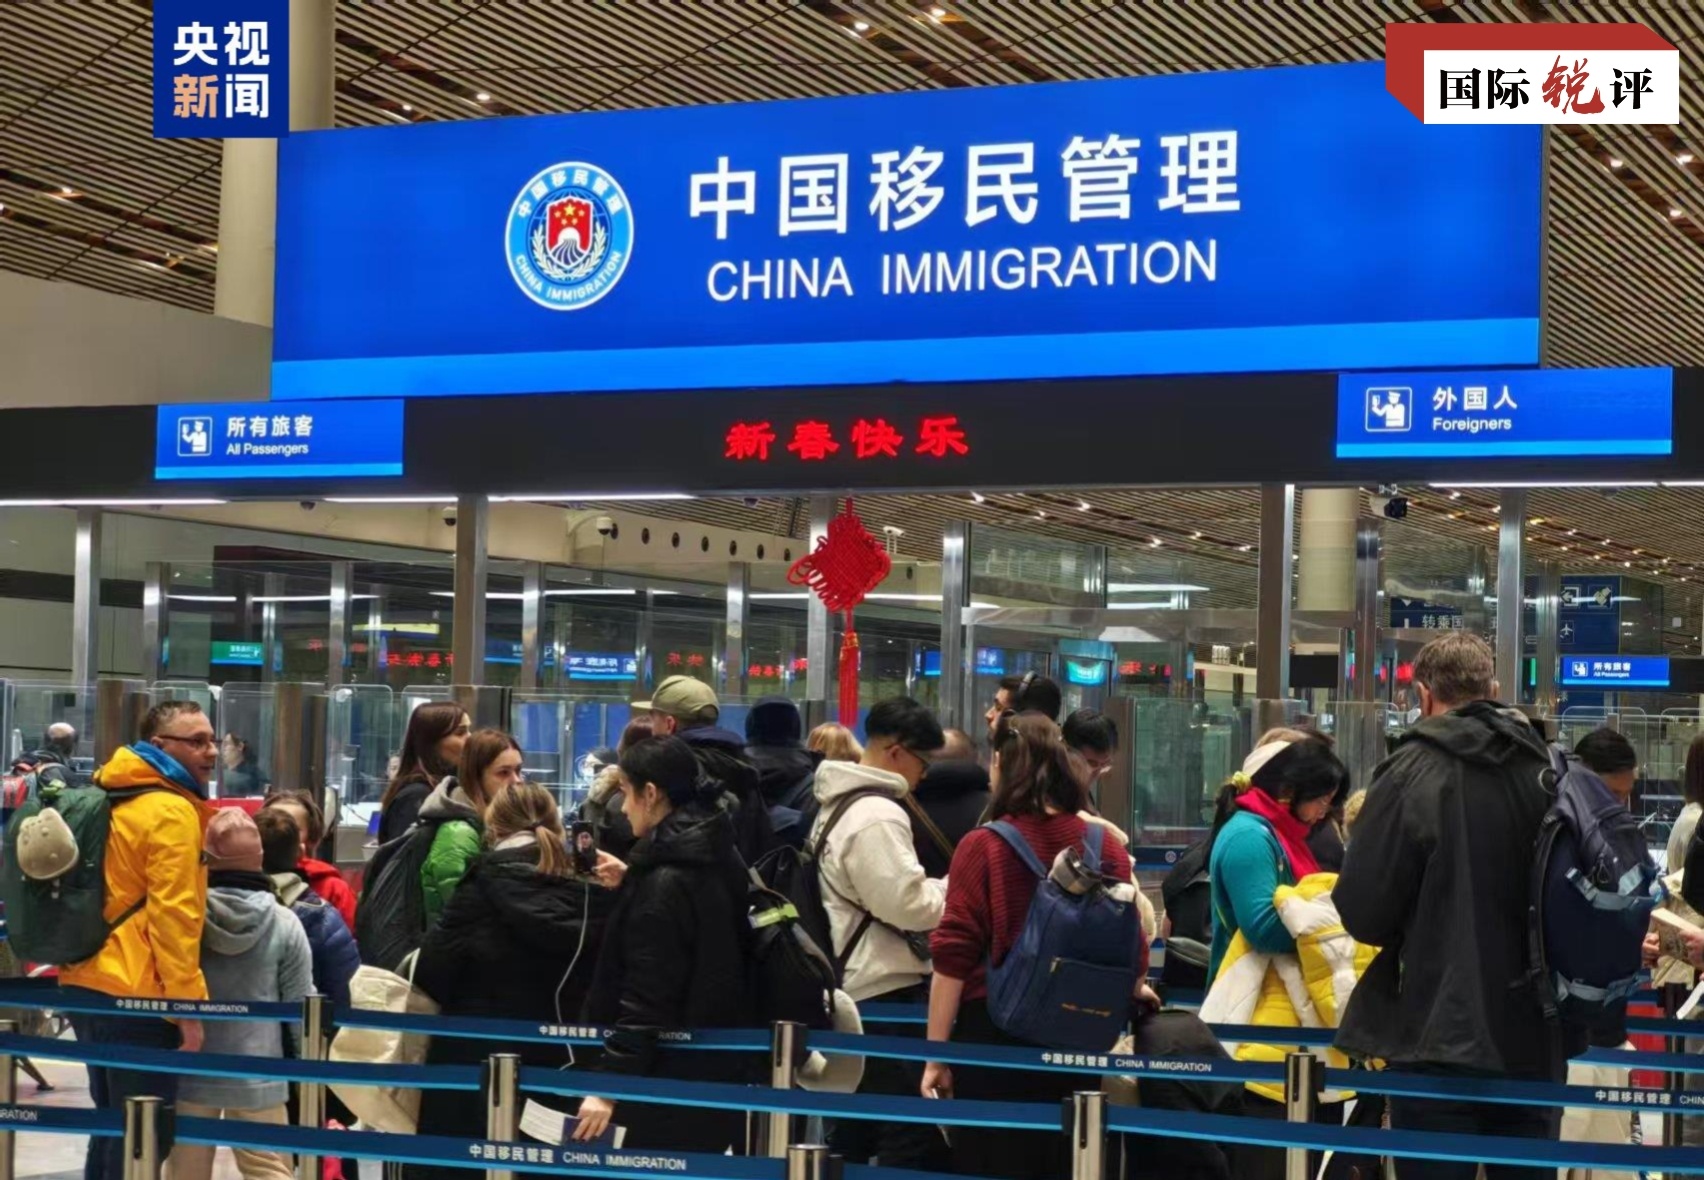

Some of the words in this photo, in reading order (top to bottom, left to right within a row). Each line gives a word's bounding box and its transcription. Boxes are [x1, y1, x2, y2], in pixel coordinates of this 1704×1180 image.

[689, 130, 1241, 241] 中国移民管理
[516, 254, 543, 294] CHINA
[546, 251, 622, 301] IMMIGRATION
[707, 256, 854, 302] CHINA
[880, 239, 1217, 296] IMMIGRATION
[1432, 385, 1518, 411] 外国人
[227, 414, 313, 438] 所有旅客
[1432, 416, 1512, 434] Foreigners
[724, 415, 969, 460] 新春快乐
[226, 443, 241, 455] All
[243, 442, 309, 457] Passengers
[173, 1002, 196, 1011] CHINA
[199, 1005, 249, 1013] IMMIGRATION
[658, 1031, 692, 1041] RATION
[1041, 1052, 1108, 1067] 中国移民管理
[1115, 1058, 1145, 1069] CHINA
[1148, 1060, 1212, 1072] IMMIGRATION
[1595, 1089, 1671, 1105] 中国移民管理
[469, 1144, 554, 1164] 中国移民管理
[562, 1151, 600, 1165] CHINA
[605, 1155, 686, 1171] IMMIGRATION
